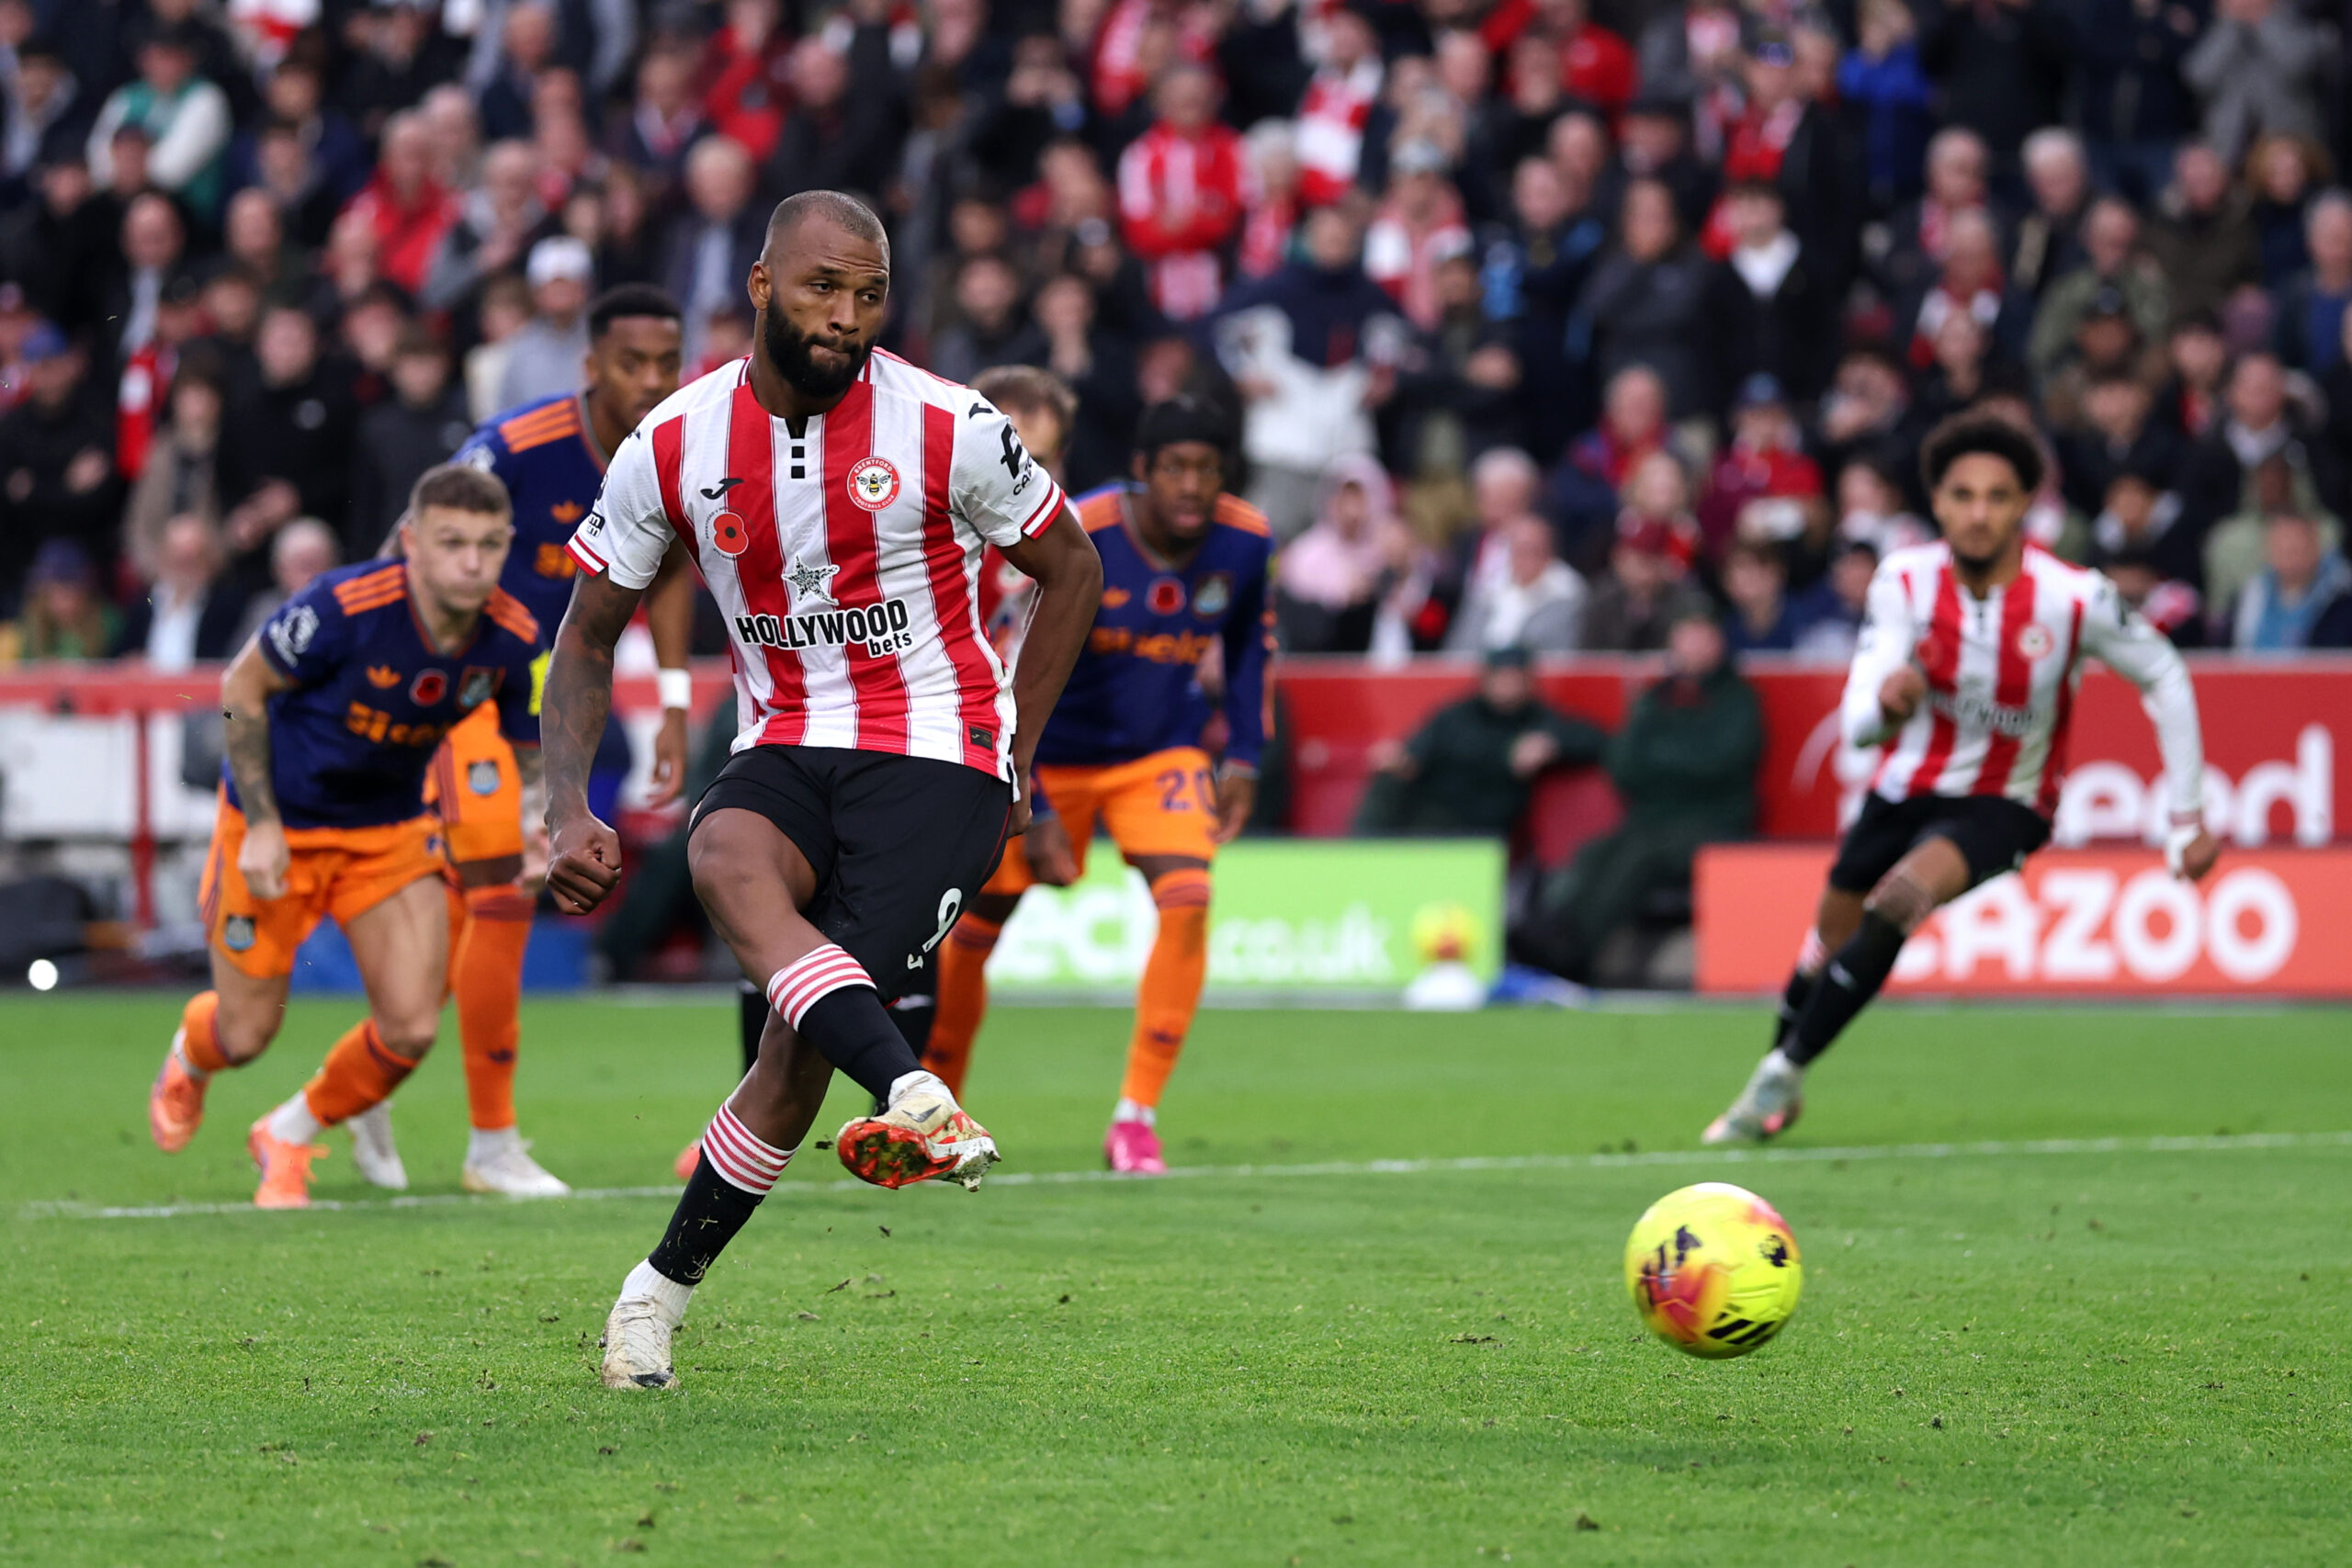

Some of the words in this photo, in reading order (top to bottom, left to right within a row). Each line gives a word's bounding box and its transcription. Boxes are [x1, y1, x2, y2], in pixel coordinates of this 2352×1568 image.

[854, 459, 893, 474] BRENTFORD
[854, 496, 881, 508] FOOTBALL
[881, 494, 895, 506] CLUB
[735, 598, 909, 649] HOLLYWOOD
[867, 623, 913, 657] bets
[922, 887, 963, 953] 9
